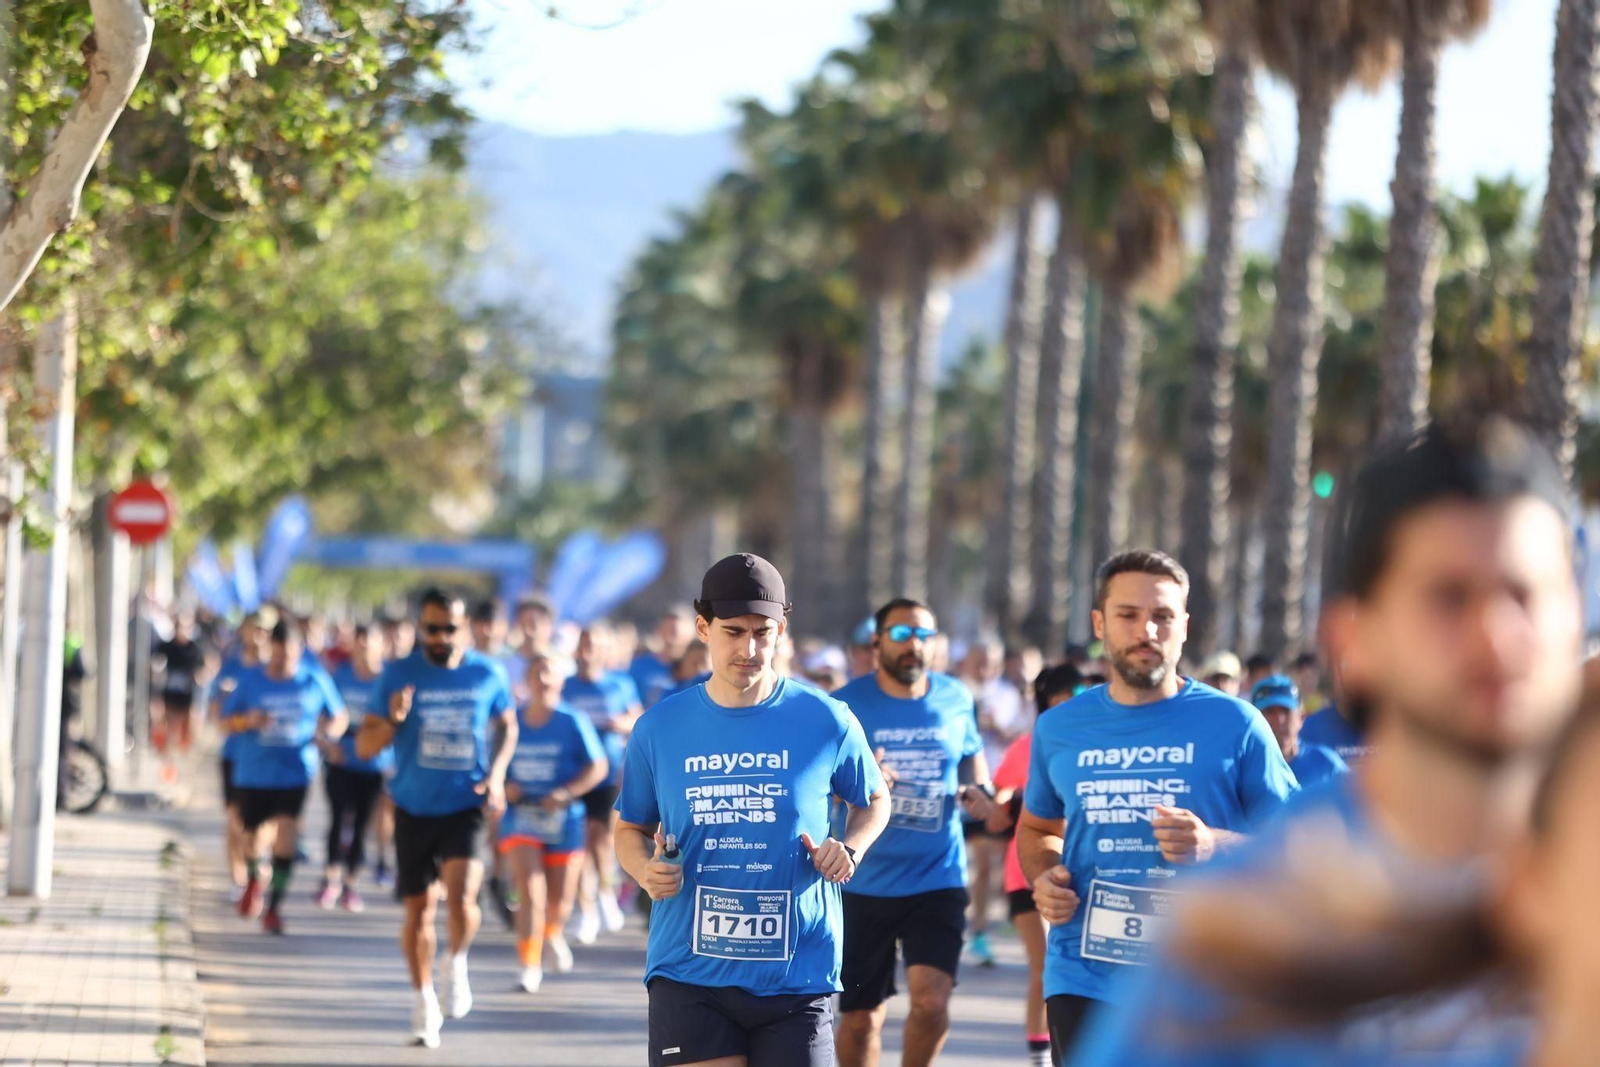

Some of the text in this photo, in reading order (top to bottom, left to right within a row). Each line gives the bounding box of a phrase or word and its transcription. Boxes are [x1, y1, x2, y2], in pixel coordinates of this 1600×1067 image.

[685, 750, 789, 774] mayoral
[1077, 742, 1194, 770] mayoral
[685, 783, 783, 800] RUNNING
[1076, 778, 1185, 796] RUNNING
[694, 797, 775, 812] MAKES
[1086, 793, 1176, 810] MAKES
[693, 810, 777, 825] FRIENDS
[1085, 808, 1158, 825] FRIEN
[713, 895, 740, 904] Carrera
[713, 902, 744, 911] Solidaria
[757, 894, 785, 902] mayoral
[707, 914, 778, 937] 1710
[1124, 916, 1143, 938] 8
